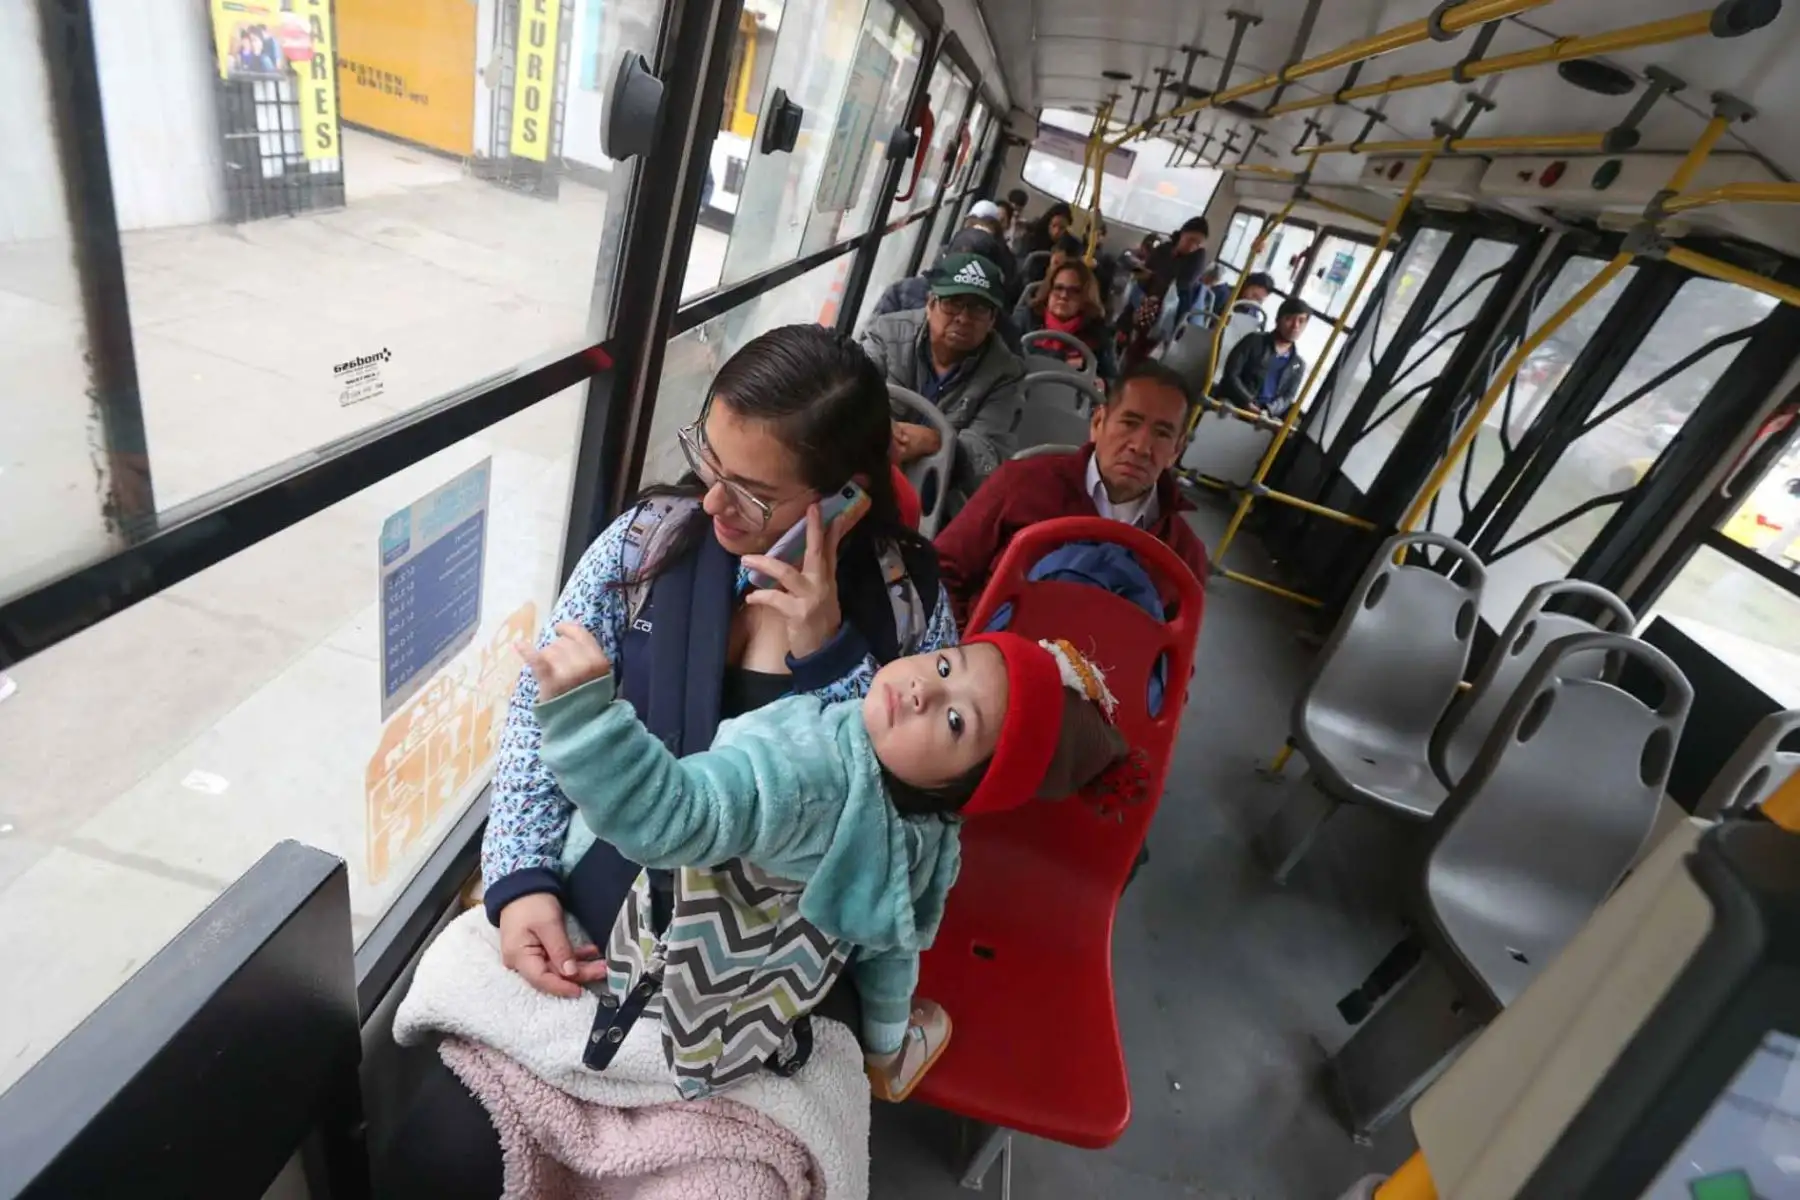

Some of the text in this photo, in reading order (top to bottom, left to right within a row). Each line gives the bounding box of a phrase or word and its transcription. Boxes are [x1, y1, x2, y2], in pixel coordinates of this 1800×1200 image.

[308, 0, 332, 149] ARES
[337, 58, 403, 86] WESTERN
[357, 75, 403, 98] UNION
[953, 274, 990, 289] adidas
